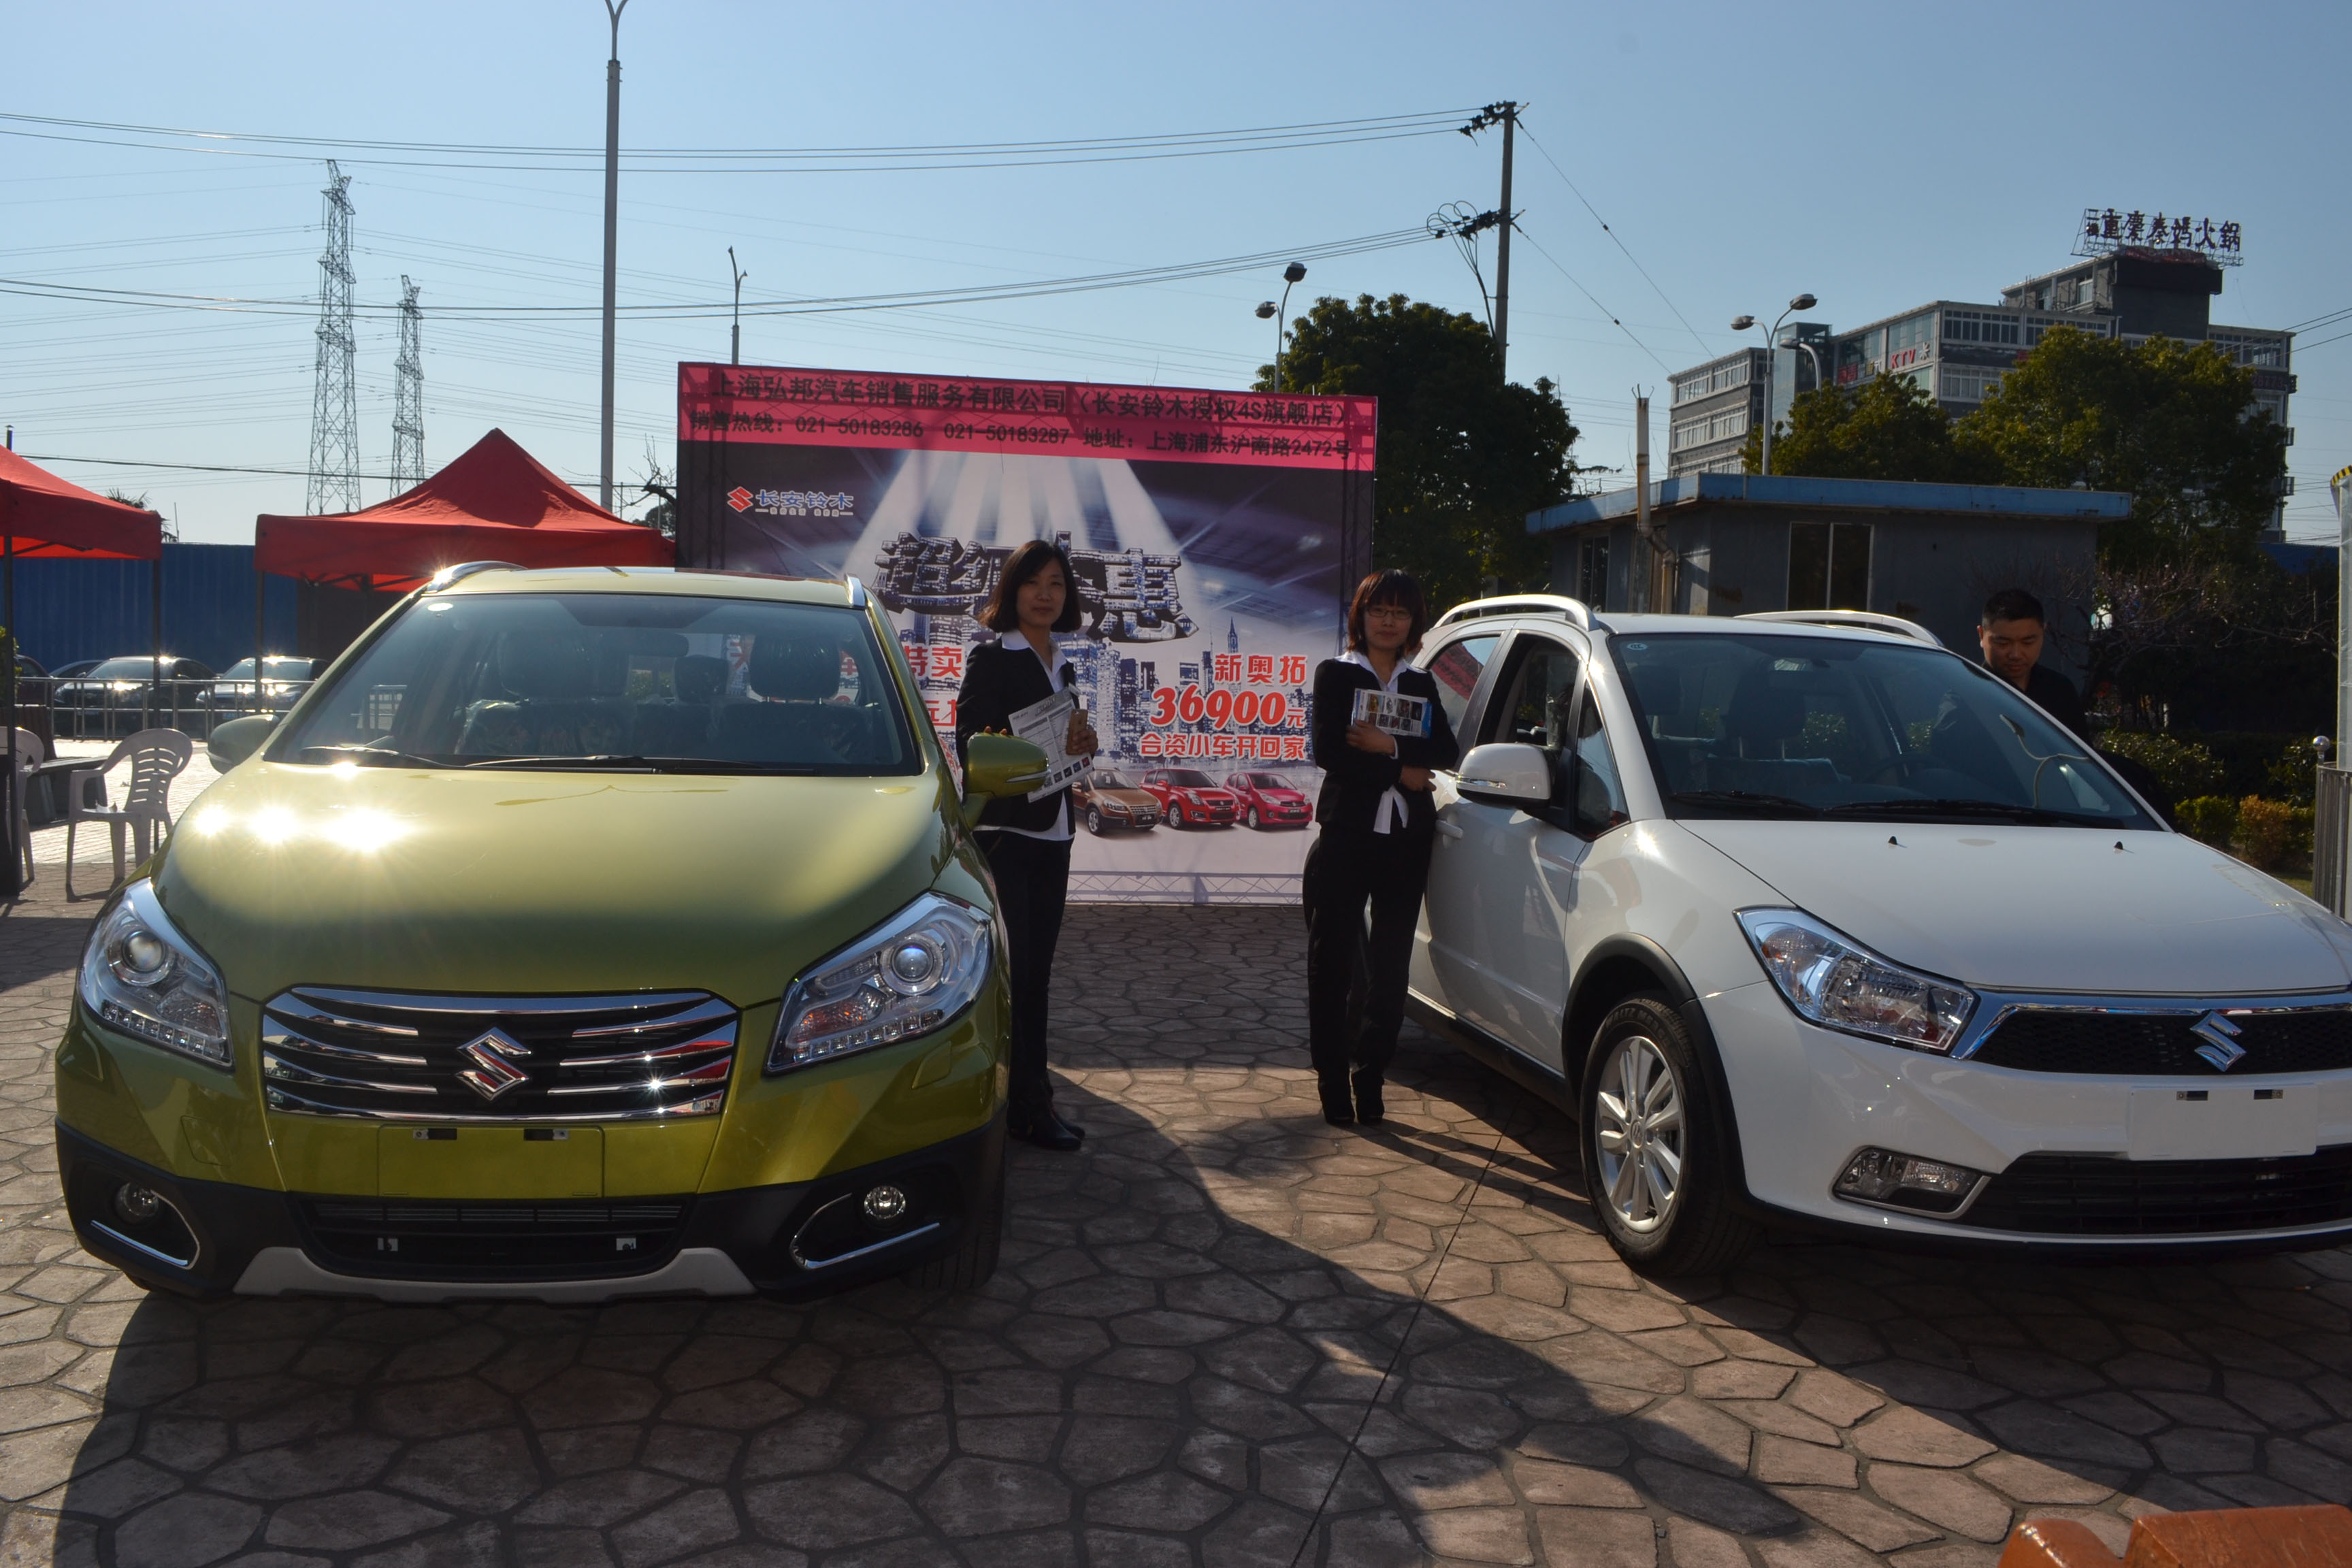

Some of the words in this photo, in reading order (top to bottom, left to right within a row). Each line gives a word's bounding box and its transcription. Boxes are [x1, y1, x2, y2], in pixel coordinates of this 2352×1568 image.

[1891, 348, 1916, 370] KTV
[943, 423, 1071, 444] 021-50183287
[755, 489, 854, 510] 长安铃木
[1214, 653, 1307, 685] 新奥拓
[1140, 732, 1305, 760] 合资小车开回家
